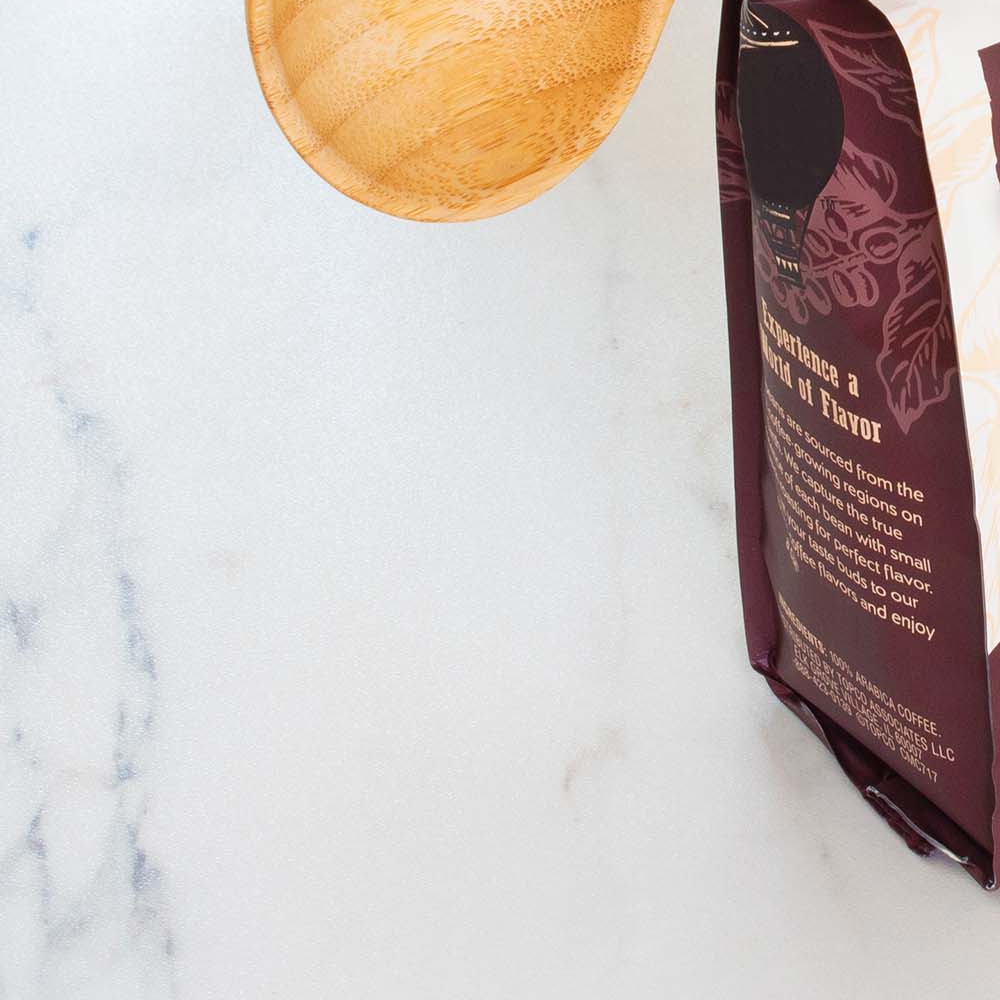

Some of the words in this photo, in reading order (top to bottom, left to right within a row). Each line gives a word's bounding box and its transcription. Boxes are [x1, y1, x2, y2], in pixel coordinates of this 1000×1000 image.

[761, 295, 840, 390] Experience
[848, 371, 860, 399] a
[798, 376, 814, 406] of
[819, 387, 882, 444] Flavor
[804, 432, 854, 474] sourced
[856, 463, 893, 493] from
[897, 481, 925, 503] the
[843, 481, 898, 517] regions
[901, 509, 924, 528] on
[795, 487, 821, 516] each
[822, 504, 853, 538] bean
[855, 529, 887, 556] with
[890, 547, 933, 574] small
[801, 469, 844, 511] capture
[847, 502, 870, 526] the
[871, 516, 904, 541] true
[808, 535, 835, 566] taste
[837, 556, 868, 590] buds
[871, 580, 887, 597] to
[890, 591, 919, 609] our
[815, 517, 831, 543] for
[834, 538, 881, 575] perfect
[884, 563, 934, 595] flavor.
[818, 562, 858, 603] flavors
[860, 598, 888, 620] and
[891, 611, 936, 641] enjoy
[838, 670, 868, 706] TOPCO
[869, 699, 929, 752] ASSOCIATES
[931, 741, 956, 763] LLC
[855, 671, 896, 710] ARABICA
[897, 703, 942, 738] COFFEE.
